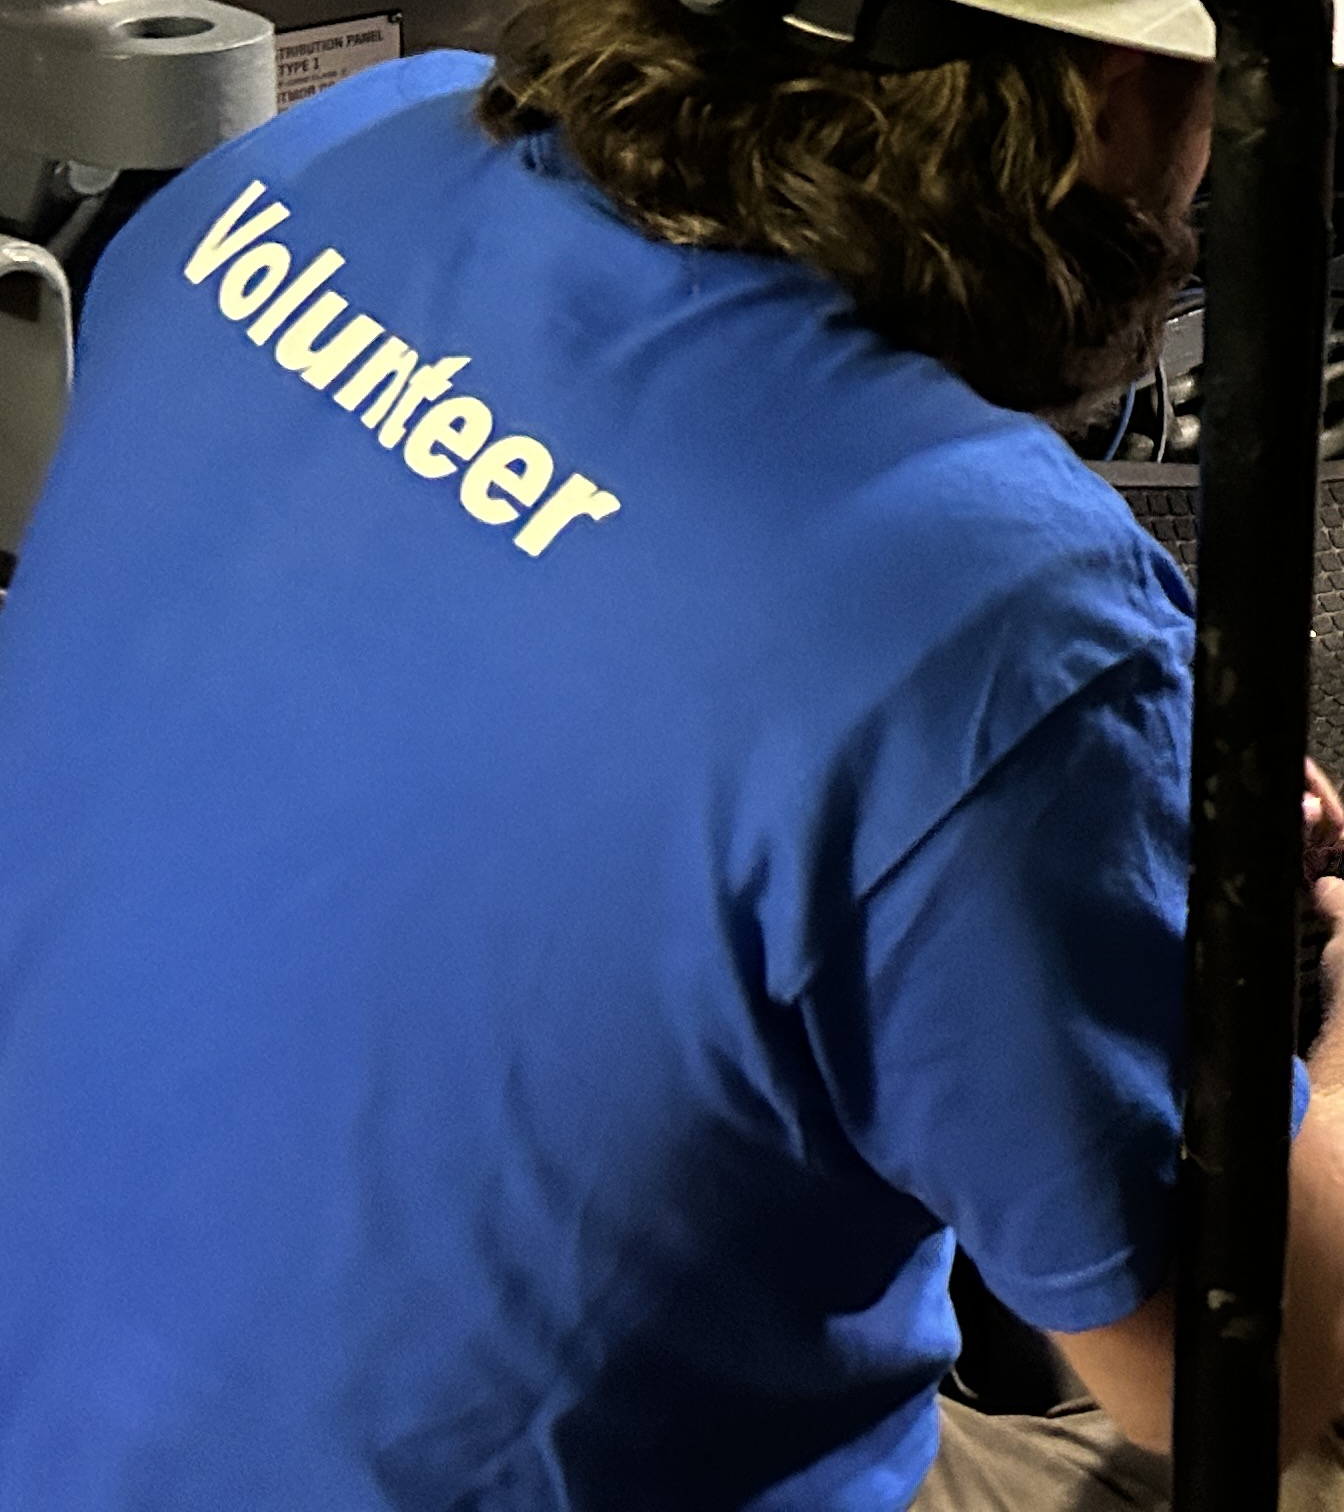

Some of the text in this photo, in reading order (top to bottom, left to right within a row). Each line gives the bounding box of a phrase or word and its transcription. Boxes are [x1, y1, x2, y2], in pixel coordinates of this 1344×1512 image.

[278, 29, 384, 62] TRIBUTION PANEL
[183, 179, 622, 557] Volunteer
